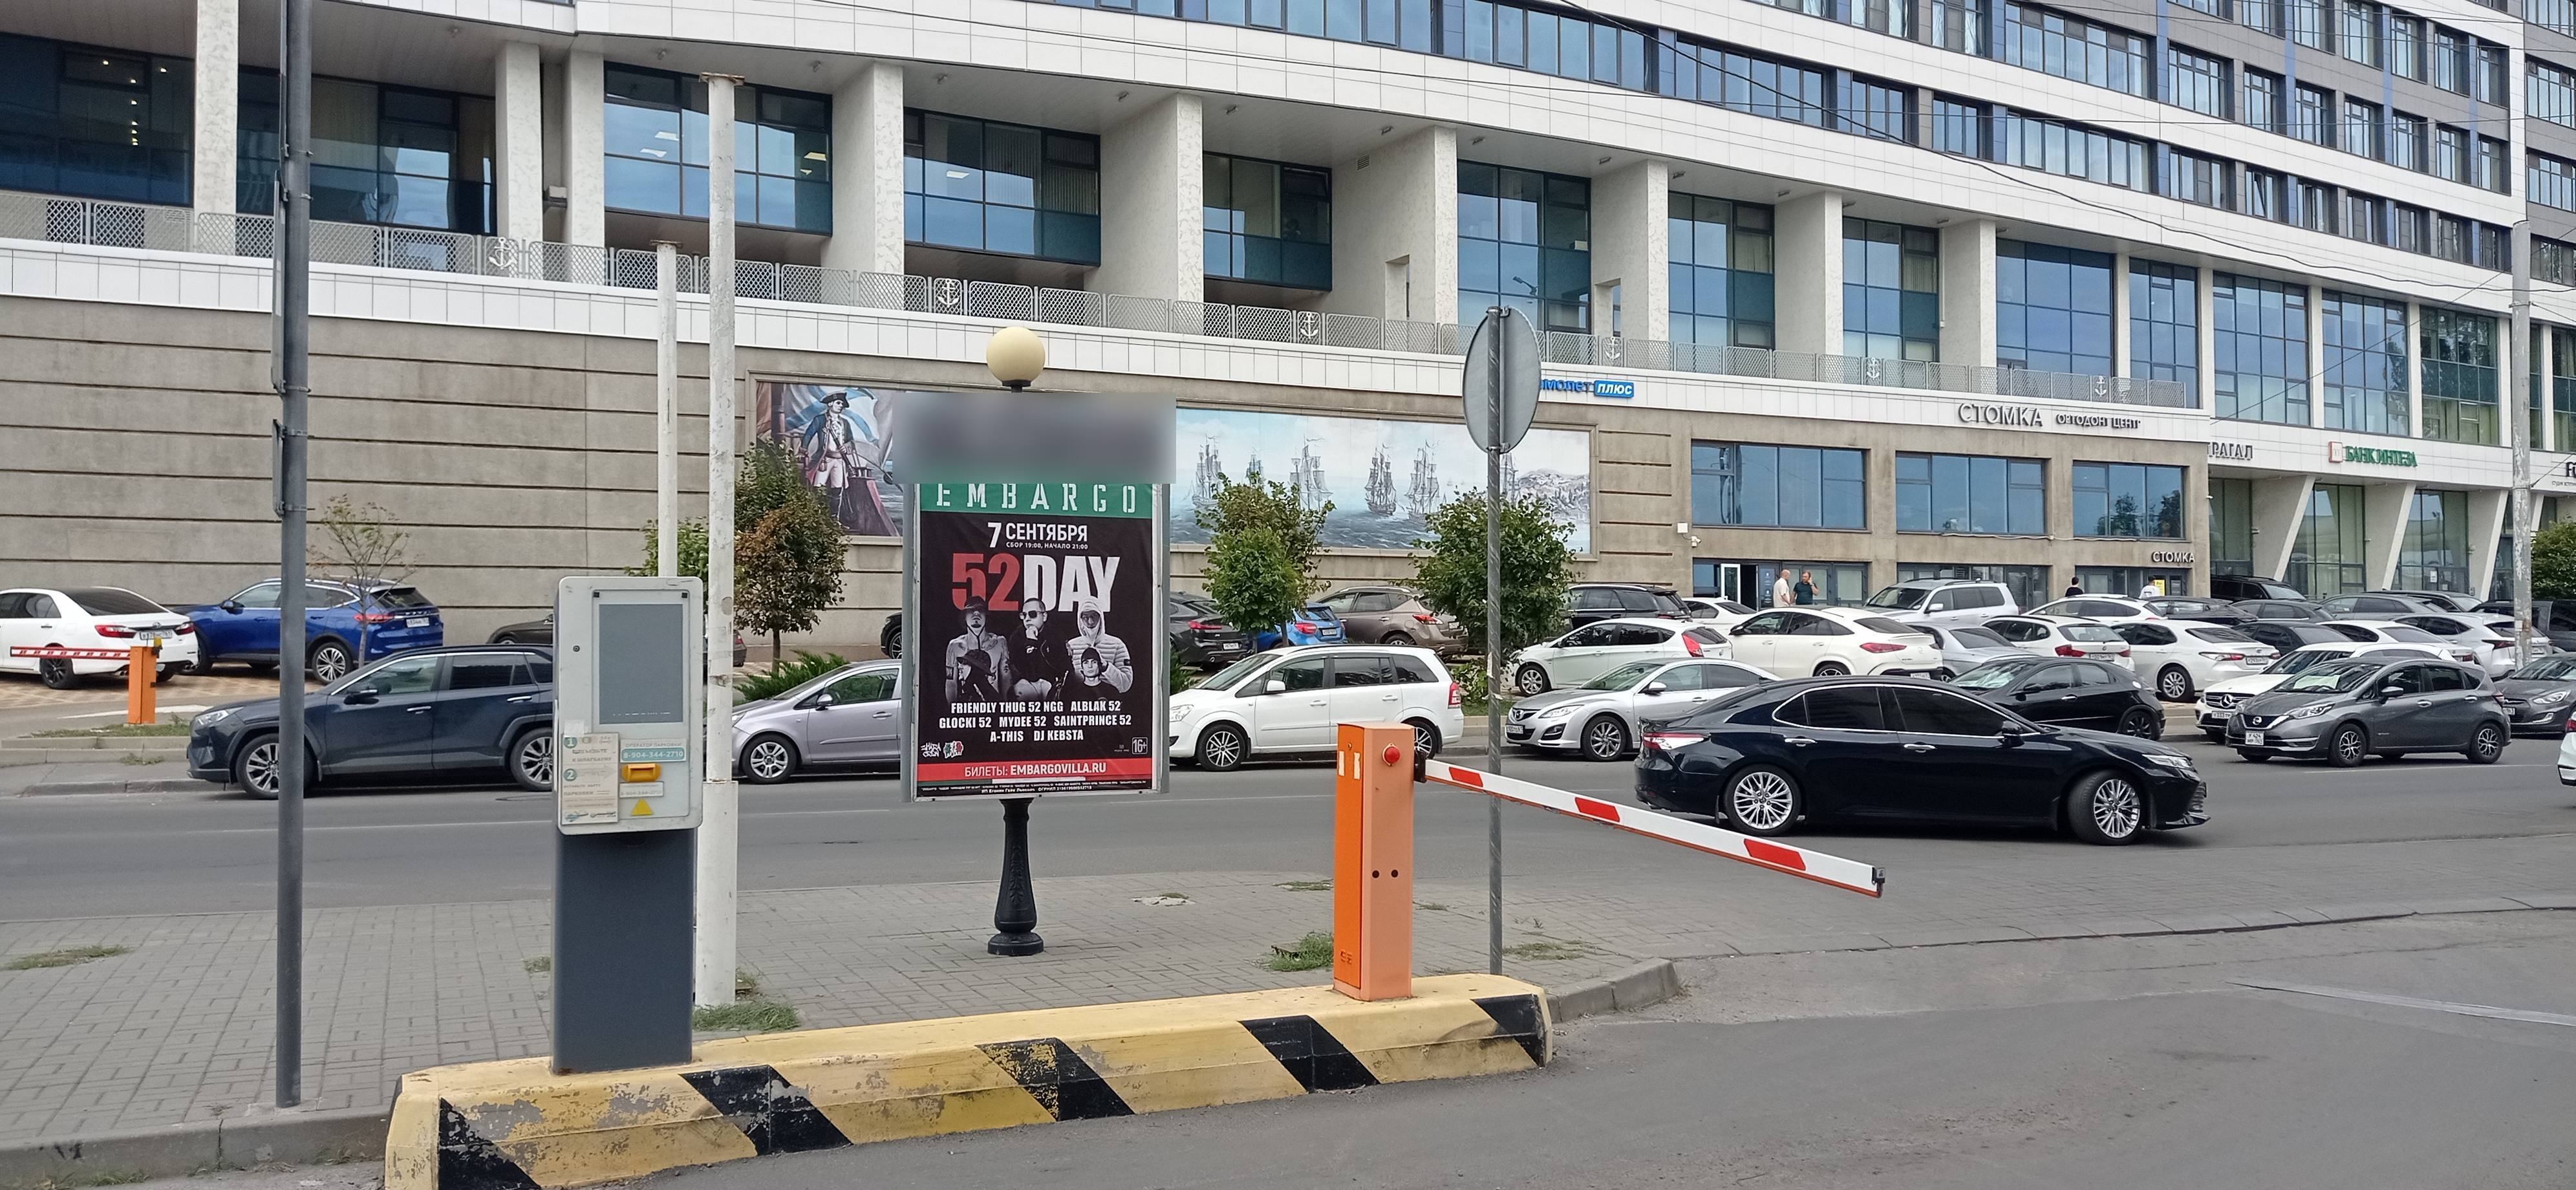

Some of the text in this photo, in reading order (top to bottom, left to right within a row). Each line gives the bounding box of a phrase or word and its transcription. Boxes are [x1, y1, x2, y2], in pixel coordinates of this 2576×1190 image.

[1959, 402, 2043, 426] СТОМКА
[2207, 442, 2253, 460] РАГАЛ
[936, 483, 1136, 514] EMBARGO
[987, 522, 1088, 548] 7 СЕНТЯБРЯ
[2151, 551, 2195, 563] СТОМКА
[951, 700, 1121, 713] FRIENDLY THUG 52 NGG ALBLAK 52
[939, 715, 1132, 728] GLOCKI 52 MYDEE 52 SAINTPRINCE 52
[990, 730, 1084, 742] A-THIS DJ KEBSTA
[1133, 739, 1147, 753] 16+
[567, 770, 574, 780] 2
[965, 763, 1106, 778] БИЛЕТЫ: EMBARGOVILLA.RU
